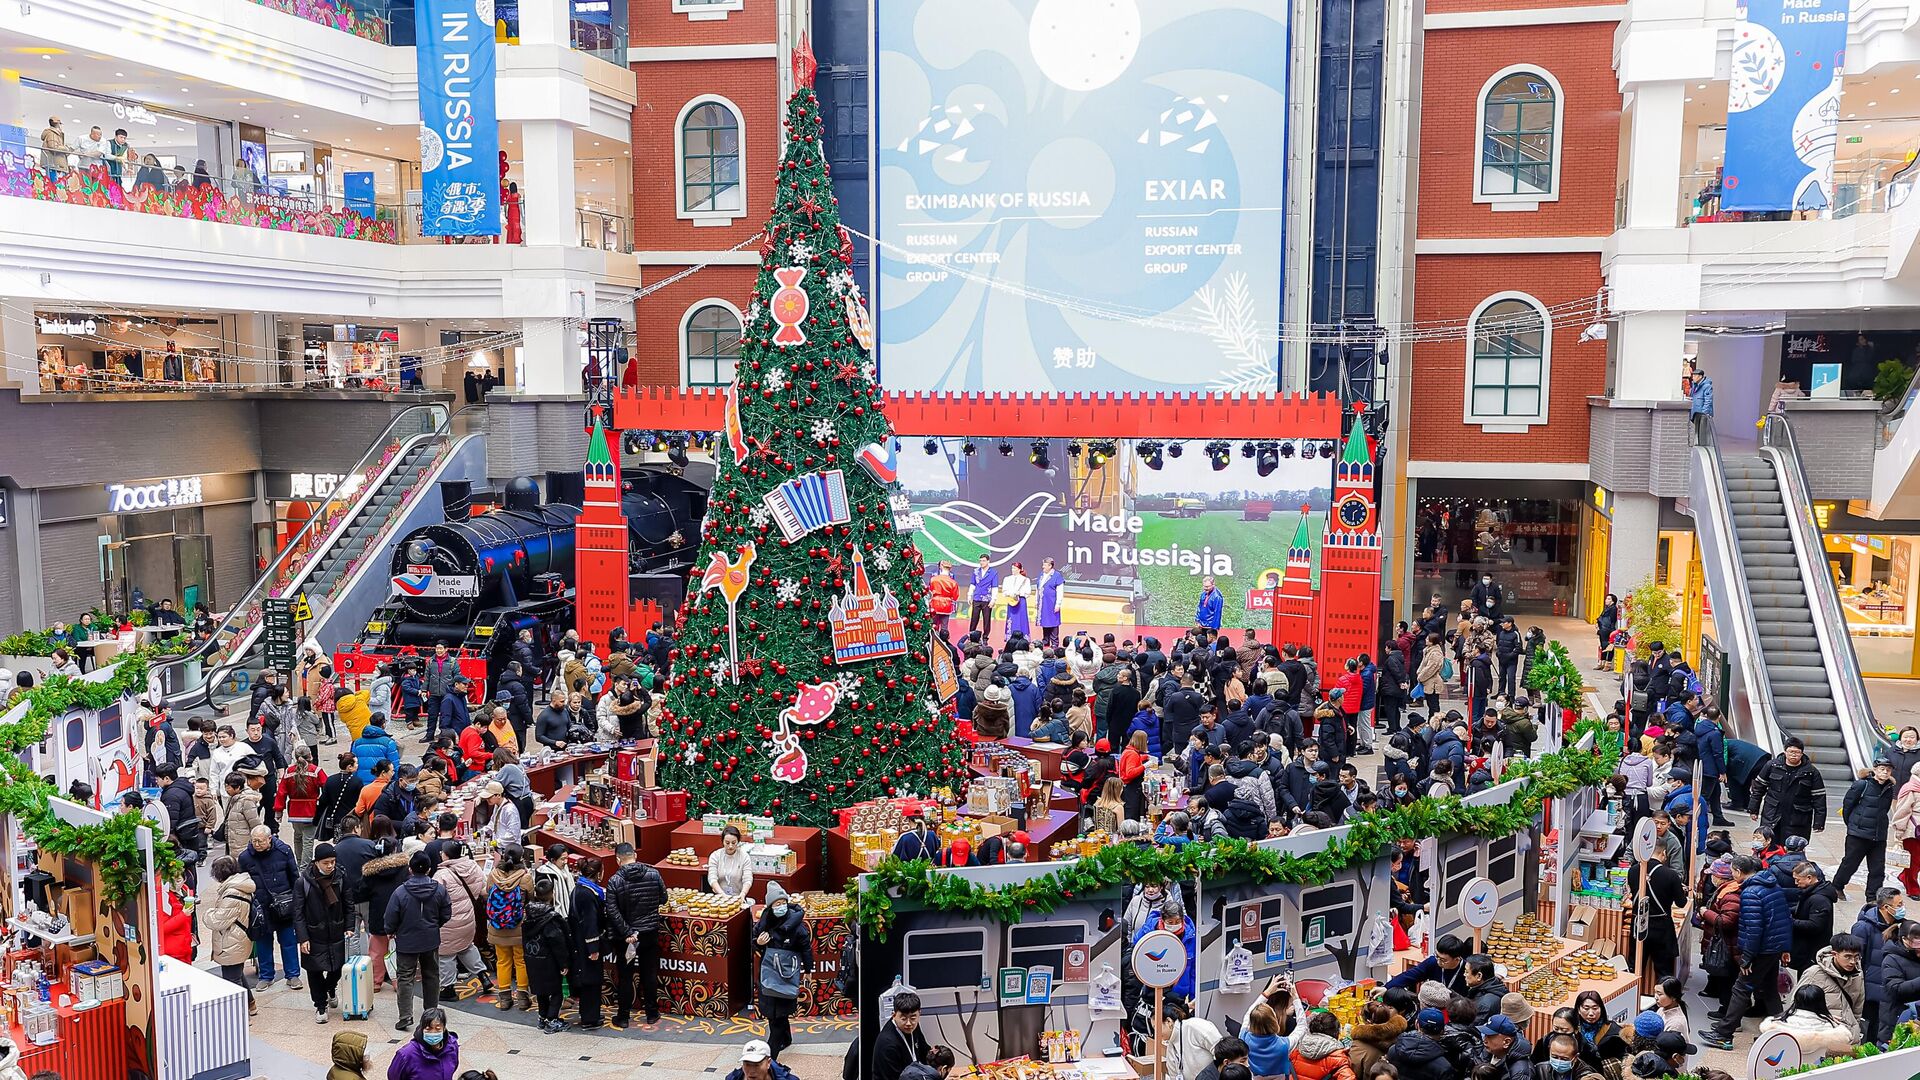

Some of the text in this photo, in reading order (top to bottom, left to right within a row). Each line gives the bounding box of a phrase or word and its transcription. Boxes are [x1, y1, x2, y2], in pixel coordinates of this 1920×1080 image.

[1783, 0, 1821, 9] Made
[1781, 10, 1846, 24] in Russia
[442, 12, 473, 170] IN RUSSIA
[1145, 179, 1226, 201] EXIAR
[905, 191, 1091, 210] EXIMBANK OF RUSSIA
[1145, 226, 1198, 238] RUSSIAN
[906, 235, 958, 246] RUSSIAN
[1144, 243, 1242, 256] EXPORT CENTER
[906, 252, 1000, 265] EXPORT CENTER
[1144, 263, 1188, 274] GROUP
[906, 271, 948, 283] GROUP
[1053, 346, 1096, 369] 赞助
[1013, 517, 1032, 526] 530
[1068, 508, 1143, 533] Made
[1067, 541, 1197, 567] in Russia
[438, 578, 461, 586] Made
[439, 587, 478, 596] in Russia
[1253, 597, 1274, 607] ВА
[660, 957, 708, 974] RUSSIA
[820, 960, 836, 973] IN
